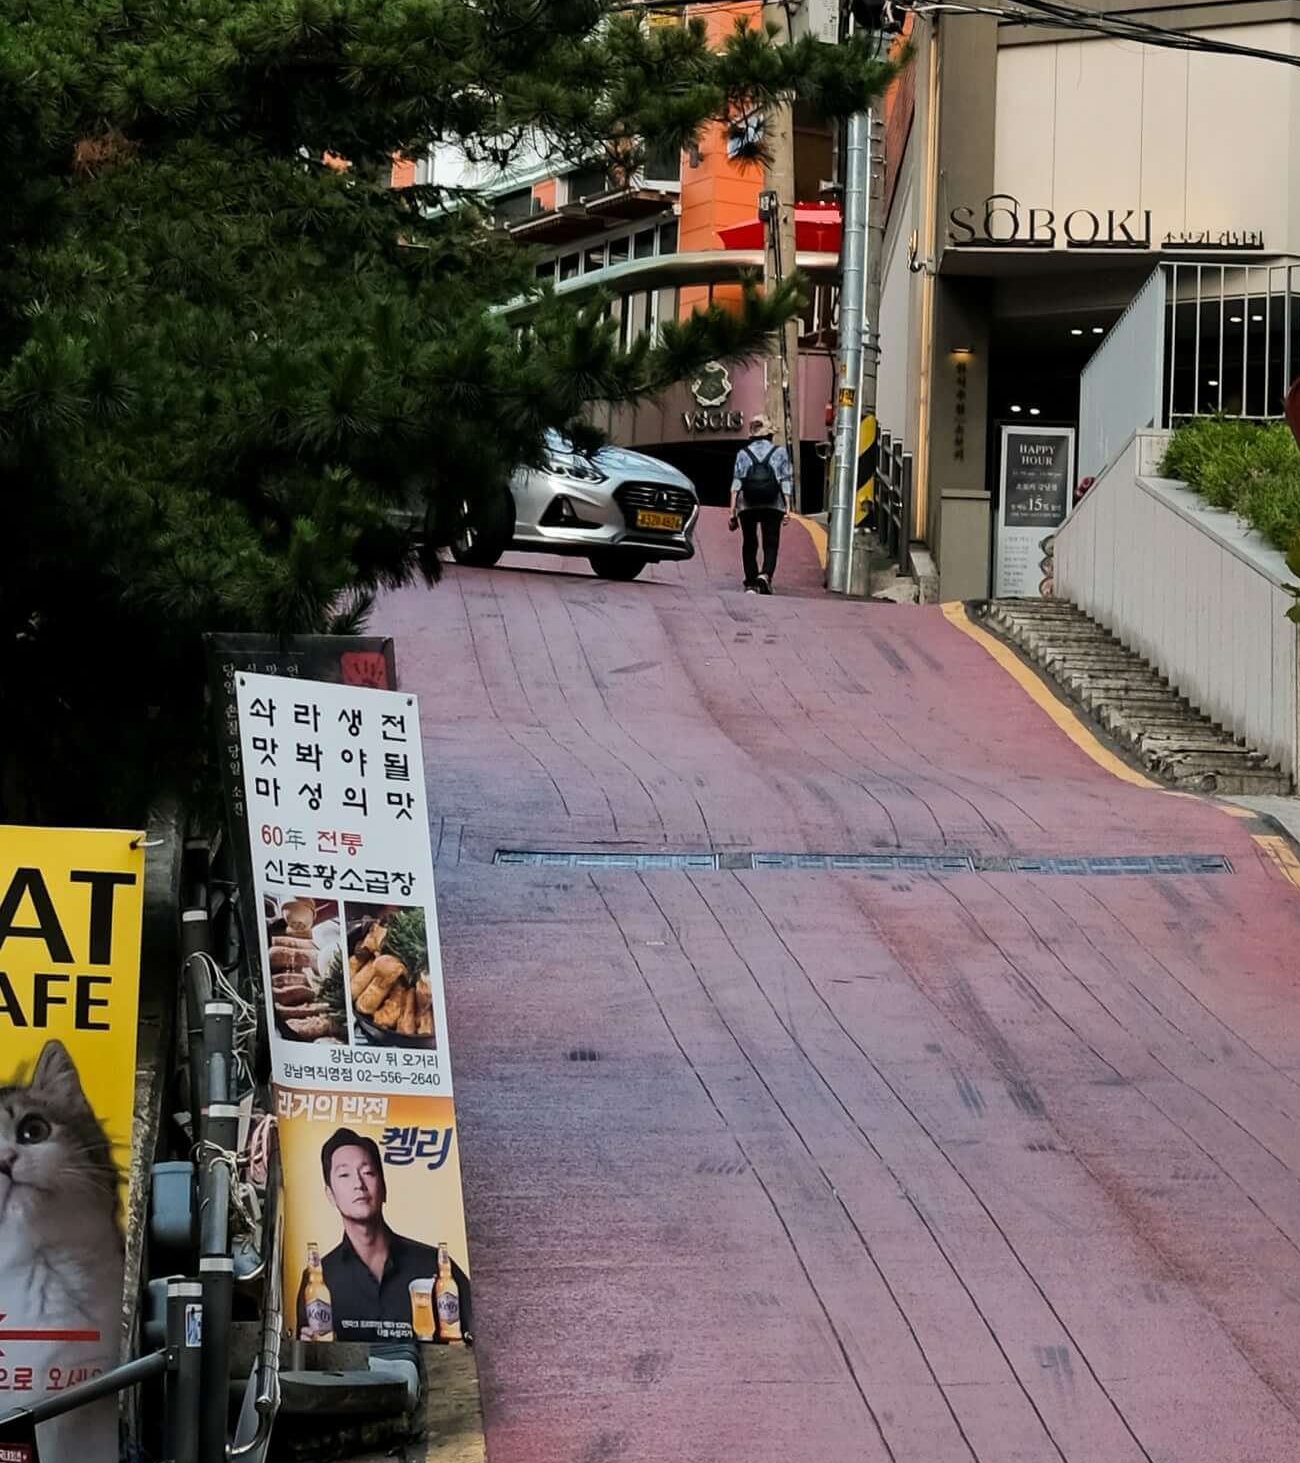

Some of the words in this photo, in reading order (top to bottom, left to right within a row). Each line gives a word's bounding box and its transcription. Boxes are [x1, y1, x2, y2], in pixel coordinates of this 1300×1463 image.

[948, 205, 1153, 245] SOBOKI
[1019, 443, 1056, 456] HAPPY
[1021, 454, 1054, 466] HOUR
[316, 829, 364, 857] 전통
[401, 1052, 439, 1070] 오거리
[282, 1062, 353, 1084] 강남역직영점
[355, 1067, 441, 1087] 02-556-2640
[276, 1089, 338, 1124] 라거의
[341, 1095, 389, 1125] 반전
[379, 1126, 454, 1171] 켈리
